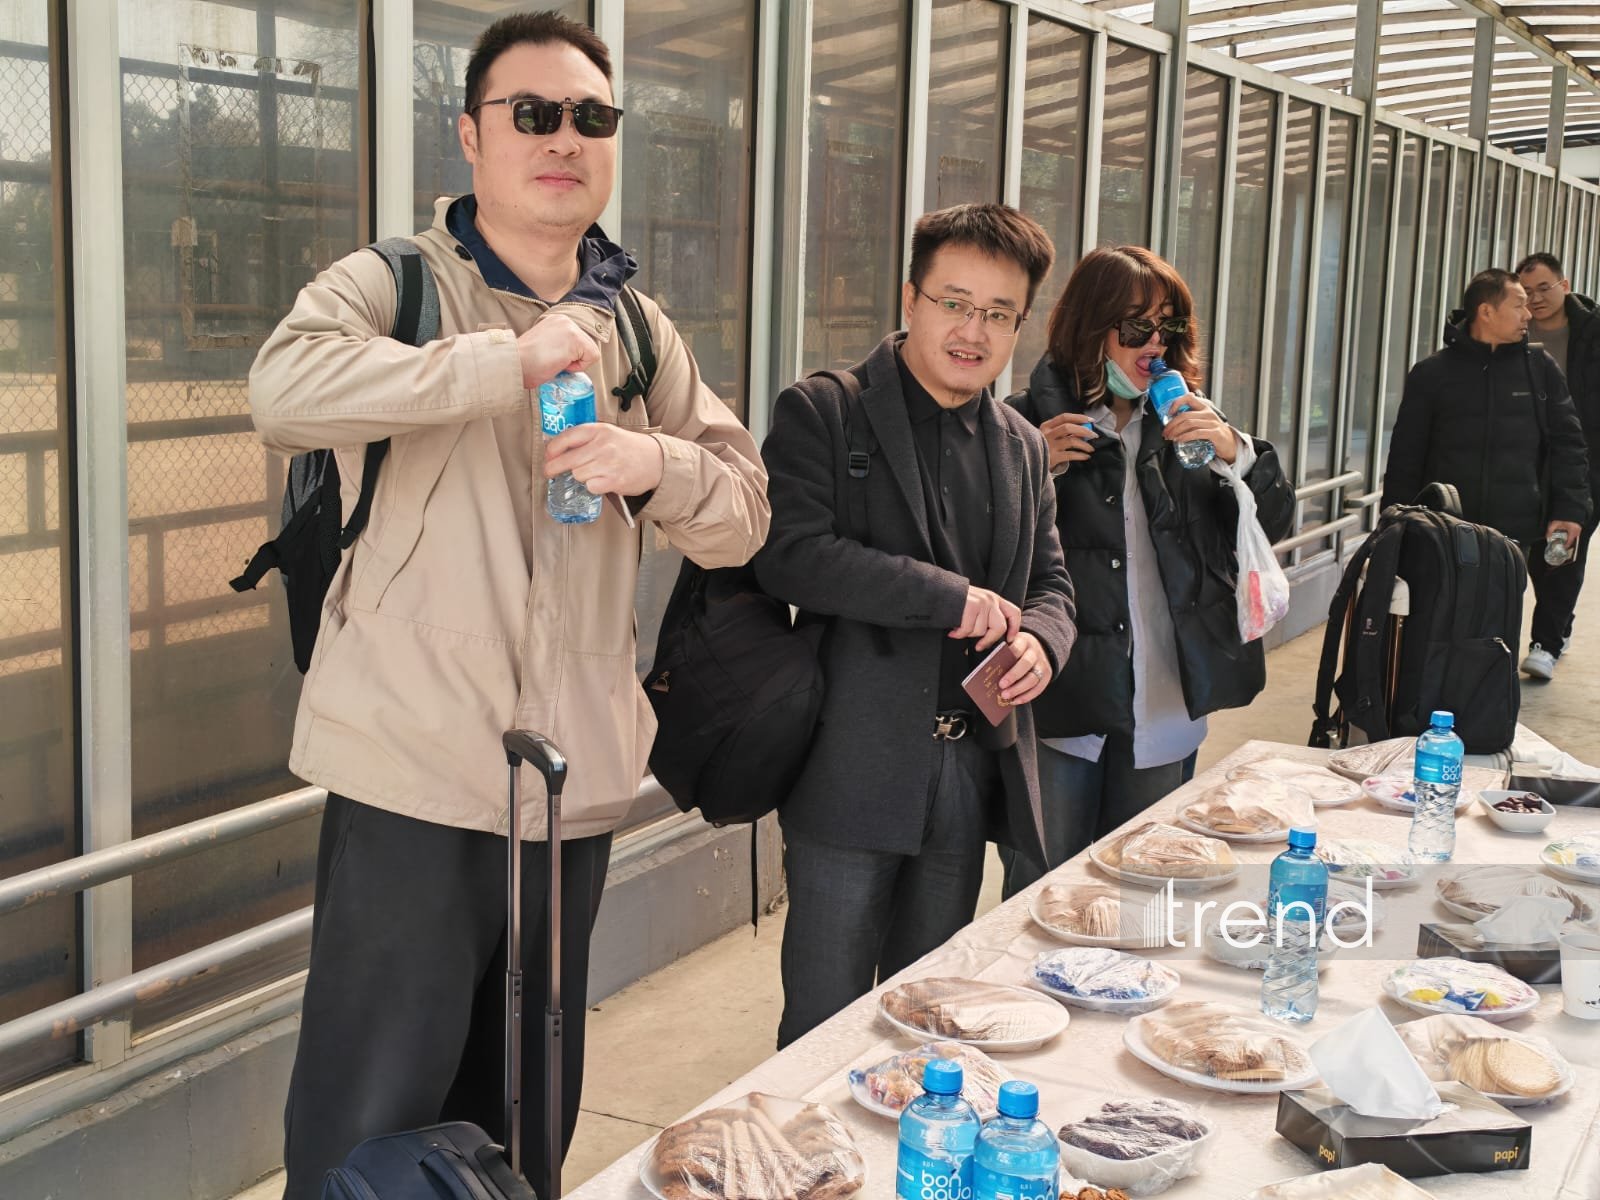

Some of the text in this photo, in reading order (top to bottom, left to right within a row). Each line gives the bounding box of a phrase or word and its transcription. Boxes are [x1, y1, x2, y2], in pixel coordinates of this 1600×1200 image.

[1318, 1144, 1336, 1163] papi
[1494, 1146, 1519, 1163] papi
[921, 1169, 962, 1188] bon
